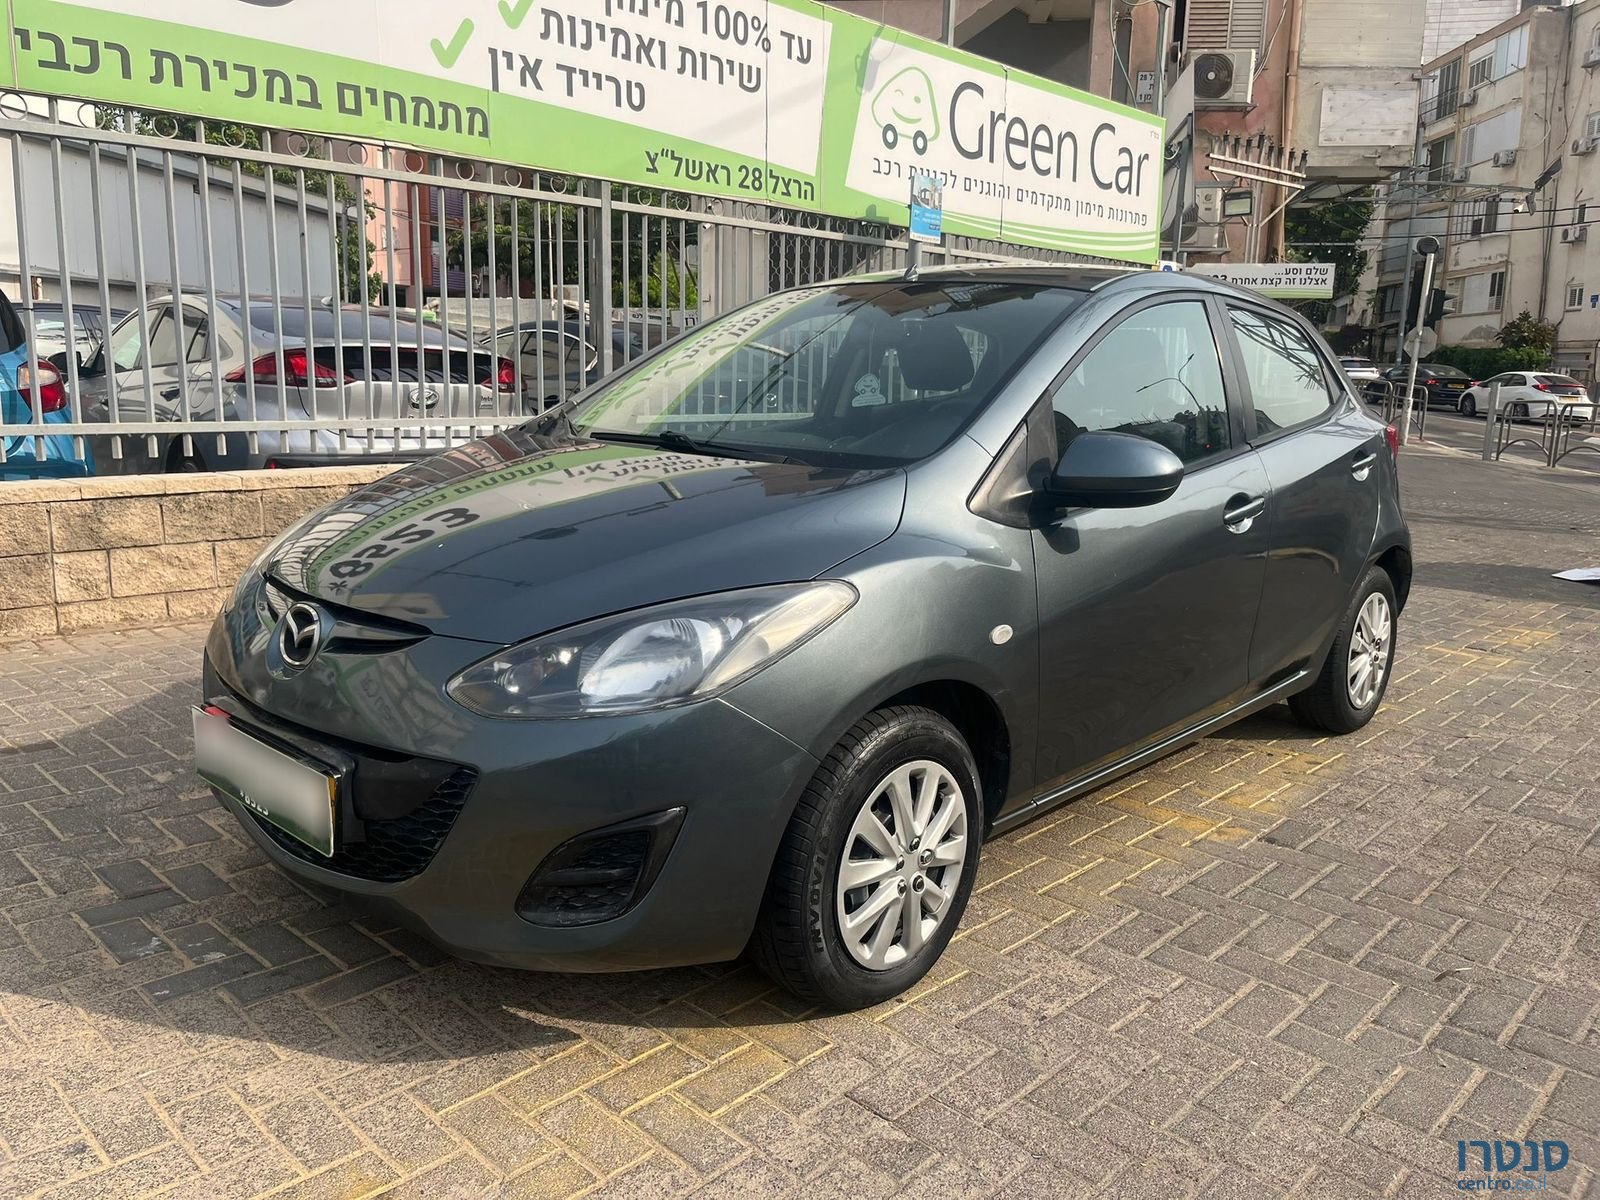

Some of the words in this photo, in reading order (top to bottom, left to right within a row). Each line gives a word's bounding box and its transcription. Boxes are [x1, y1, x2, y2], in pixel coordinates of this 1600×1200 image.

[539, 7, 666, 71] ואמינות
[696, 1, 771, 53] 100%
[780, 30, 812, 64] עד
[149, 49, 322, 111] במכירת
[488, 46, 544, 93] אין
[677, 45, 761, 93] שירות
[556, 62, 646, 112] טרייד
[337, 81, 490, 139] מתמחים
[949, 80, 1079, 183] Green
[1090, 122, 1149, 197] Car
[738, 164, 763, 192] 28
[872, 157, 901, 178] רכב
[768, 168, 815, 201] הרצל
[963, 176, 1011, 200] והוגנים
[1016, 187, 1071, 213] מתקדמים
[1075, 199, 1104, 218] מימון
[1107, 206, 1148, 227] פתרונות
[1260, 277, 1282, 287] קצת
[1285, 277, 1297, 285] זה
[1299, 276, 1328, 286] אצלנו
[1305, 266, 1329, 275] שלם
